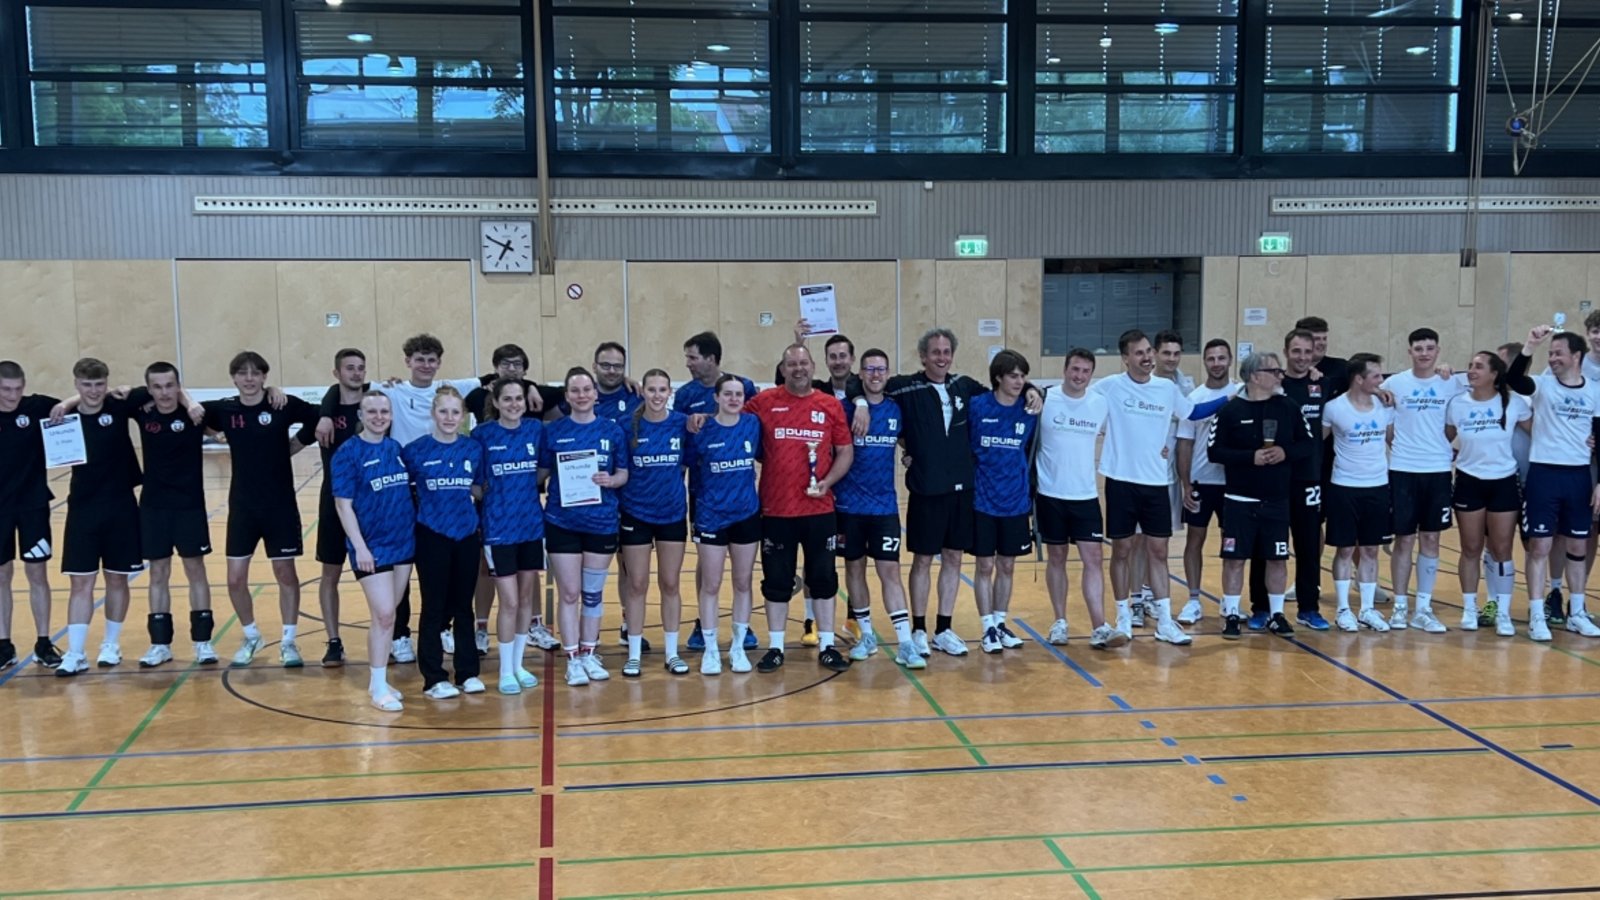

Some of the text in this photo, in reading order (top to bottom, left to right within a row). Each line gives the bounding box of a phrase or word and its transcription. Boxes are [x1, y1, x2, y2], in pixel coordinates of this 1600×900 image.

[231, 414, 245, 429] 14
[810, 410, 826, 424] 50
[786, 428, 825, 438] DURST
[600, 439, 610, 451] 11
[669, 437, 681, 450] 21
[642, 454, 681, 463] DURST
[383, 472, 409, 484] DURS
[882, 536, 900, 551] 27
[1275, 542, 1288, 555] 13
